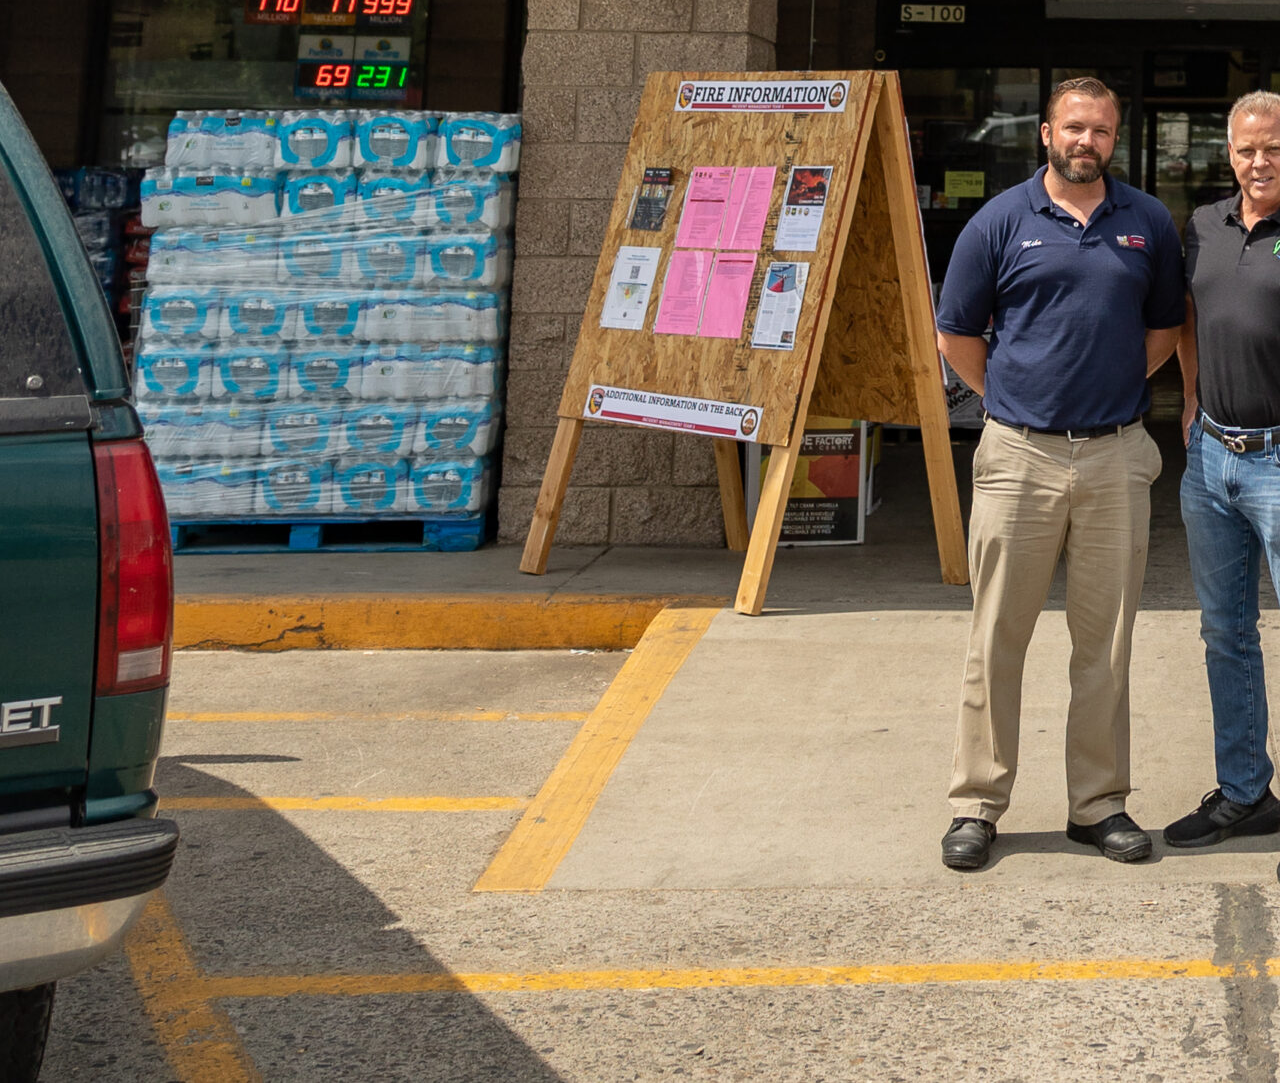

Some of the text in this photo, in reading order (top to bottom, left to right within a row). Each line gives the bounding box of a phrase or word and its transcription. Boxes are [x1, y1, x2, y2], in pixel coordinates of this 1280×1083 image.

[903, 6, 963, 21] S-100
[315, 64, 351, 87] 69
[357, 66, 408, 87] 231
[693, 86, 830, 103] FIRE INFORMATION
[1021, 239, 1042, 249] Mike
[605, 390, 744, 417] ADDITIONAL INFORMATION ON THE BACK
[815, 437, 852, 446] FACTORY
